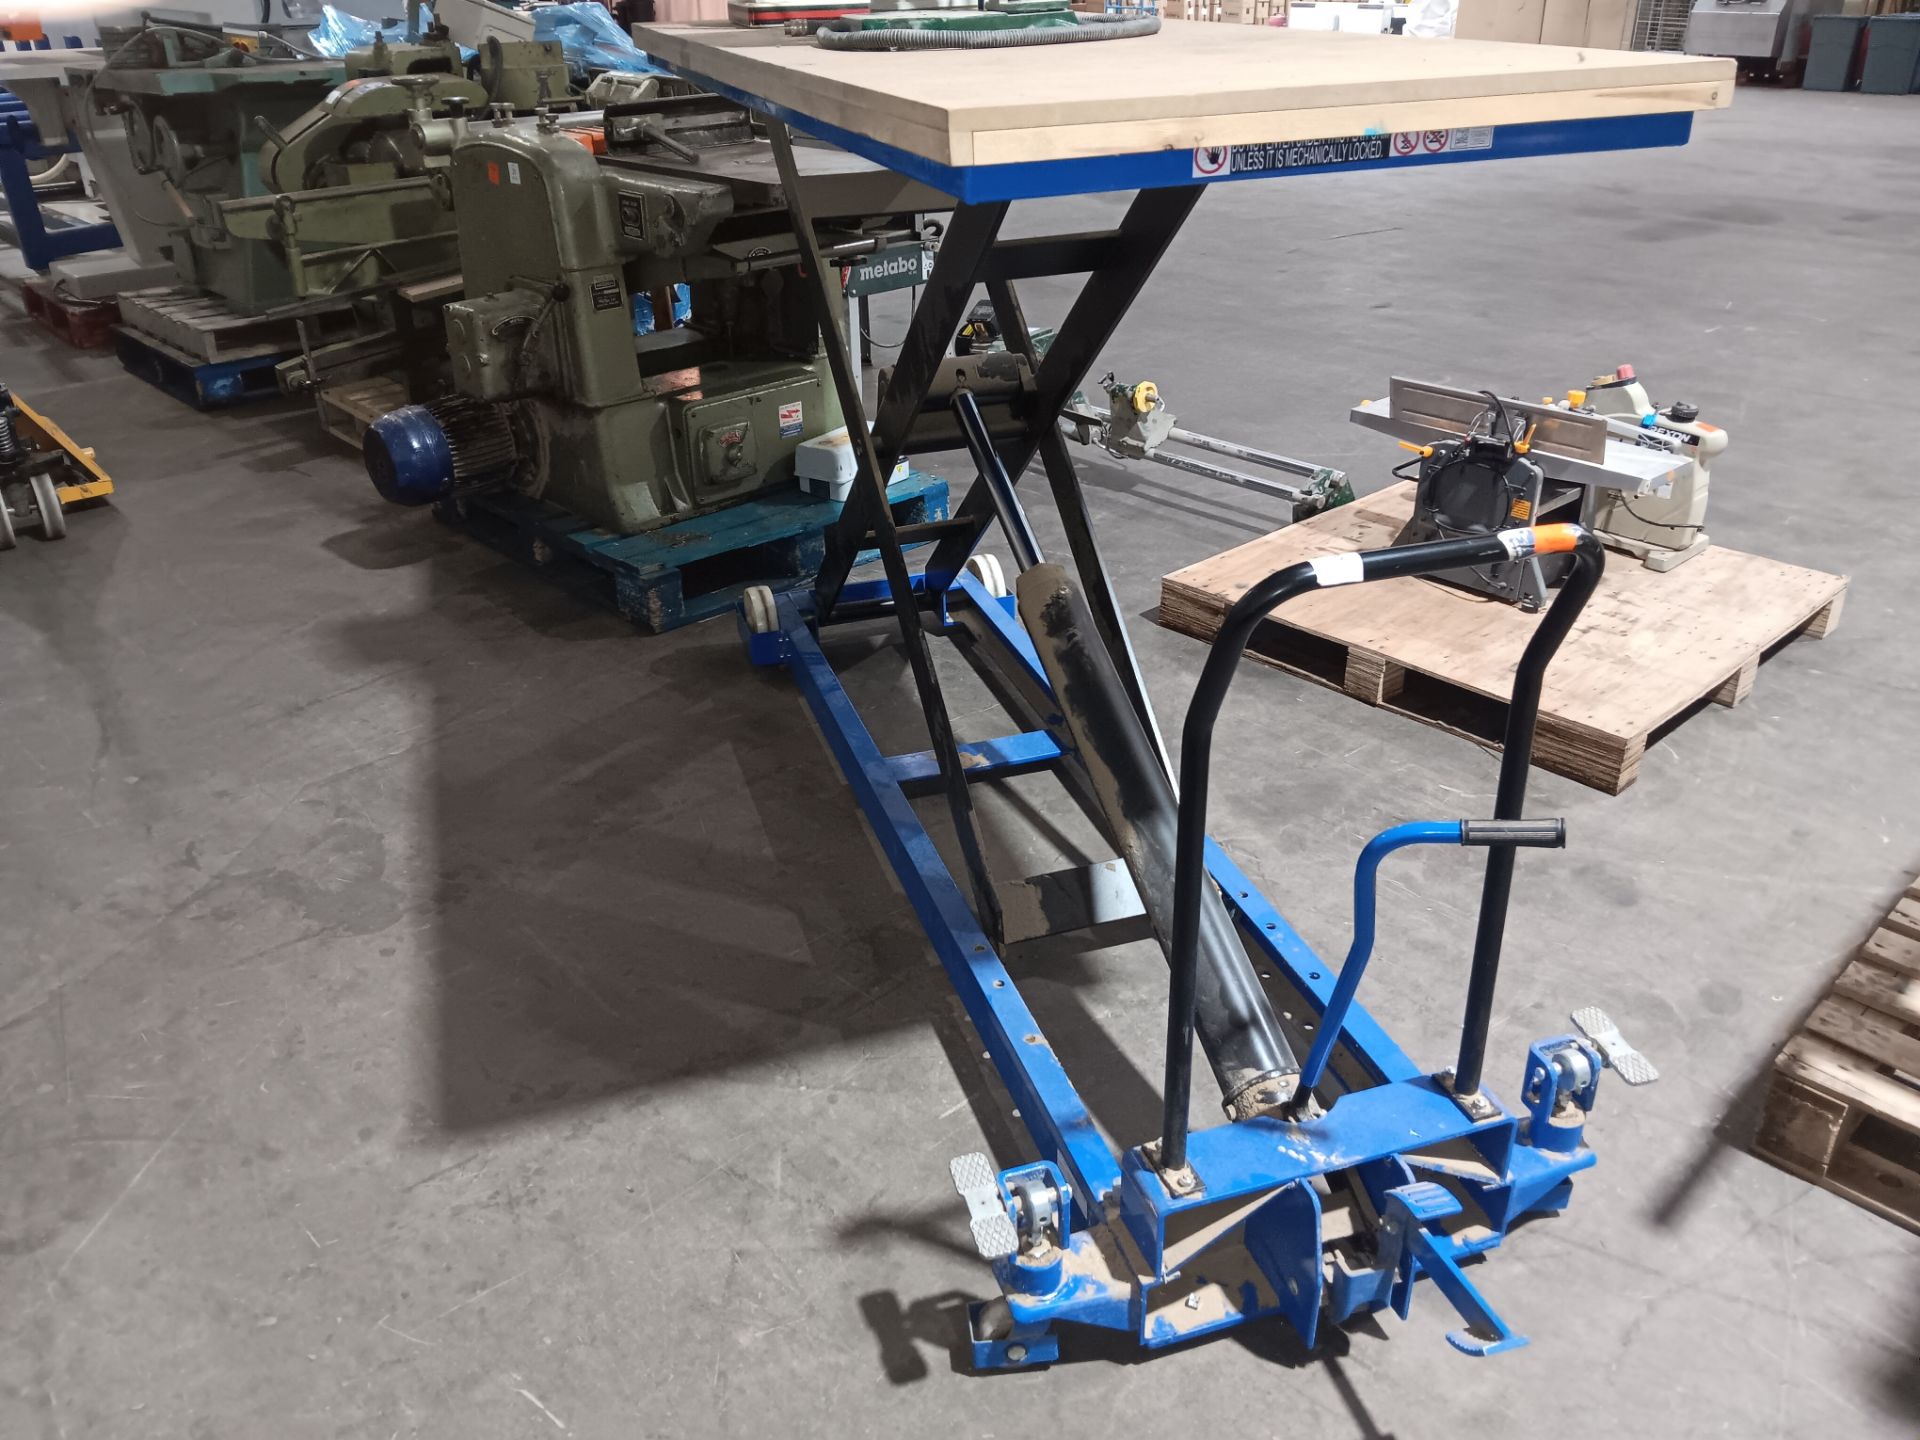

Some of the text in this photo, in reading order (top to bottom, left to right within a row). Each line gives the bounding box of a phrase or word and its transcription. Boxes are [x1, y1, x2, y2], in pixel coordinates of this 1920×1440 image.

[1231, 151, 1264, 172] UNLESS
[1265, 150, 1275, 169] IT
[1275, 149, 1284, 168] IS
[1285, 143, 1348, 167] MECHANICALLY
[1348, 140, 1384, 161] LOCKED.
[860, 257, 917, 280] metabo
